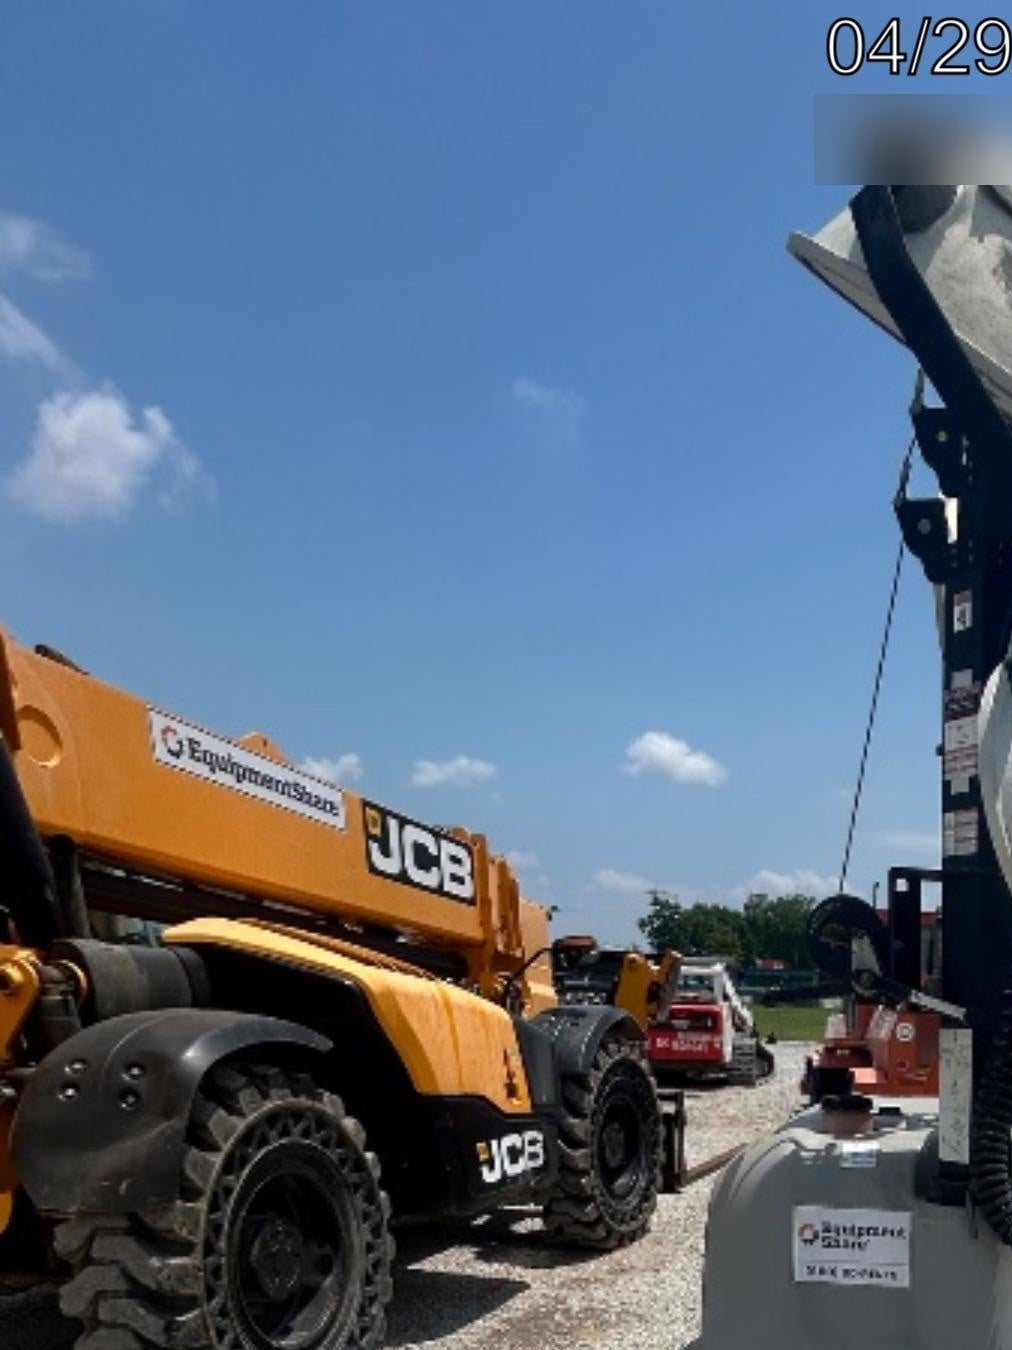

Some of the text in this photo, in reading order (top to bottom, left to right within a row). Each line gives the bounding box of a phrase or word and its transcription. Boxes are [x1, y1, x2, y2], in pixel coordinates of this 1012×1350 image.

[187, 737, 340, 816] EquipmentShare
[368, 815, 474, 898] JCB
[481, 1130, 543, 1183] JCB
